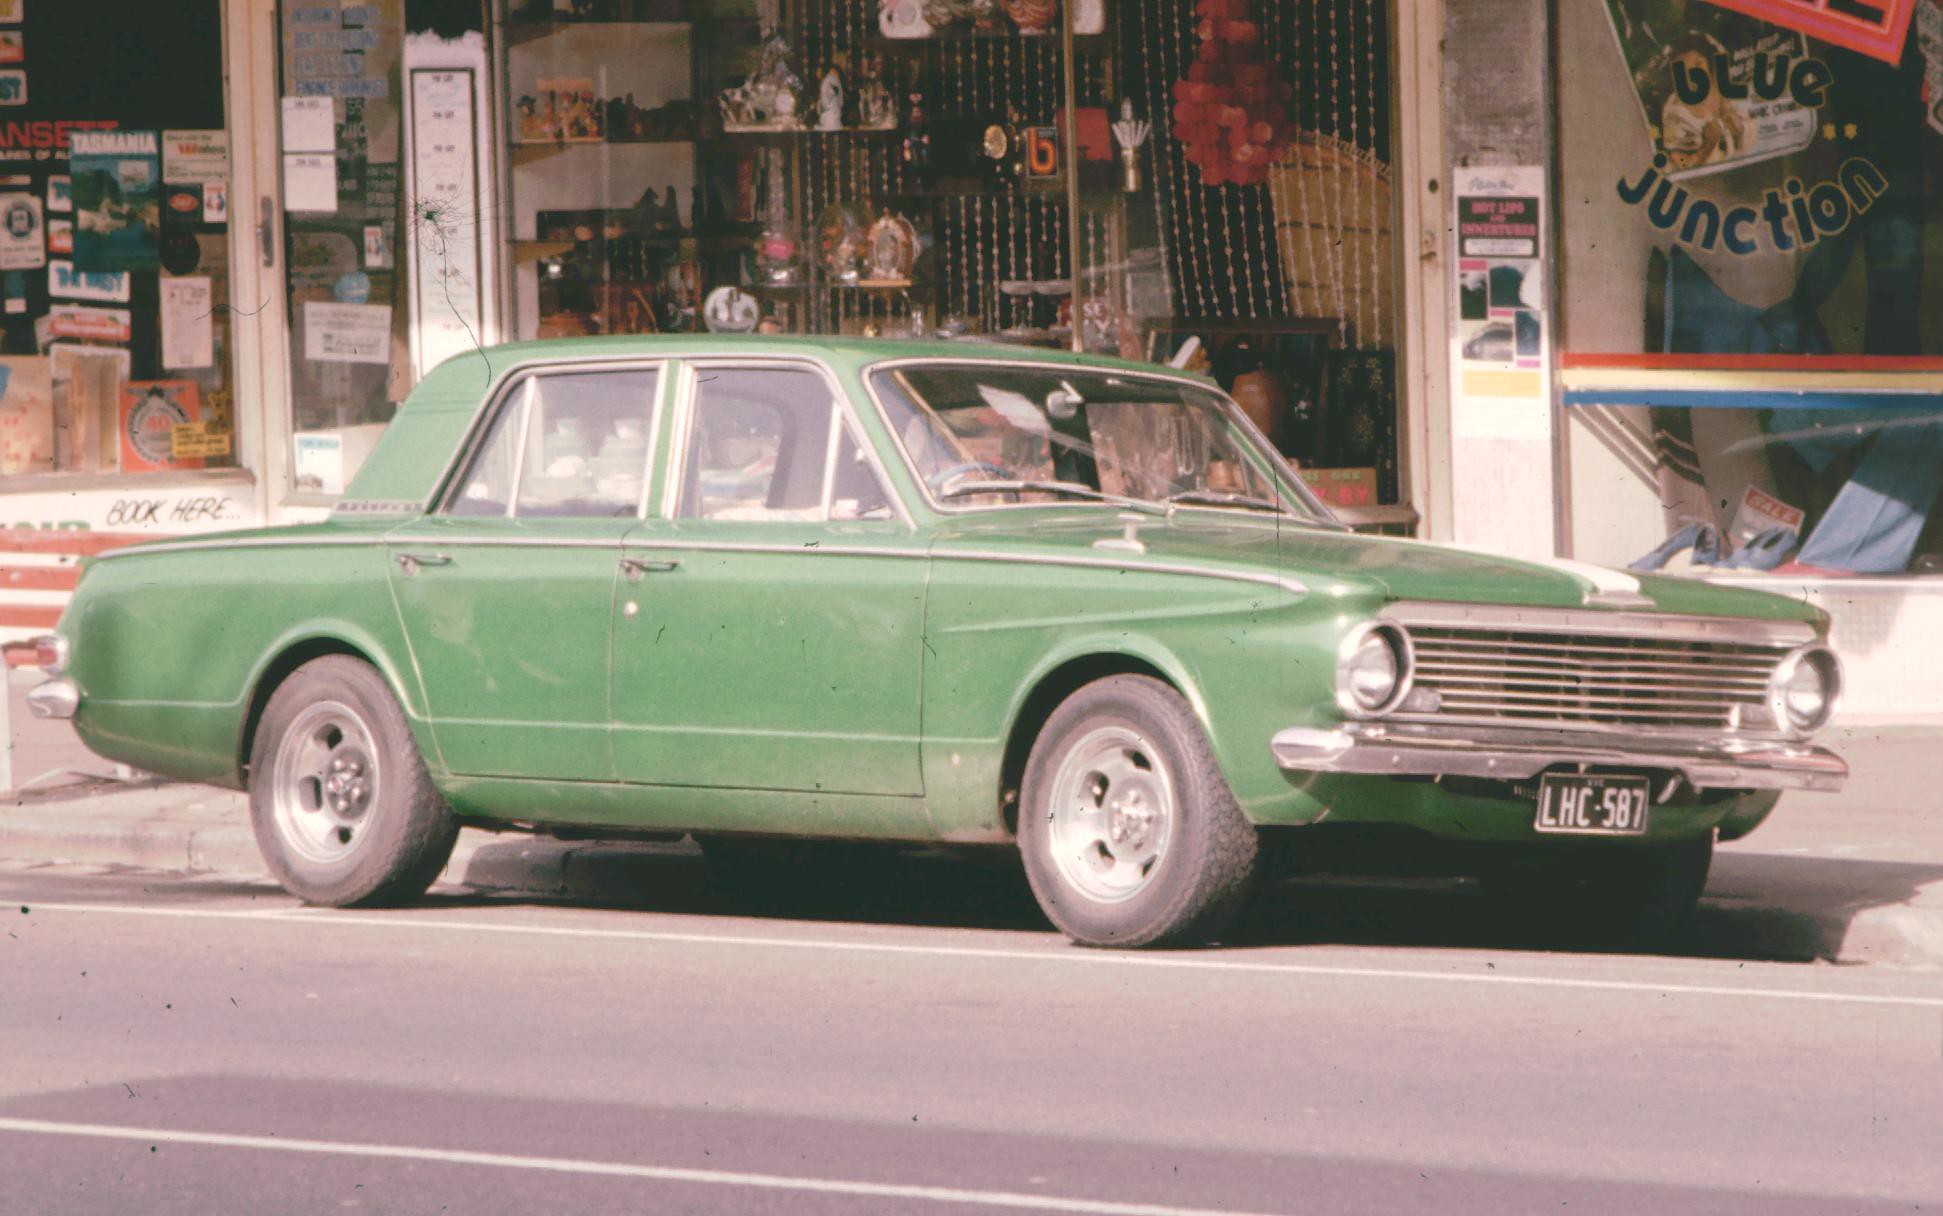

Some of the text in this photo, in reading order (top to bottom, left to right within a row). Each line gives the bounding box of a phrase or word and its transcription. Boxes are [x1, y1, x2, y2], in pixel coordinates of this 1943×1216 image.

[72, 132, 157, 154] TASMANIA
[107, 499, 167, 526] BOOK
[1748, 493, 1798, 524] SALE
